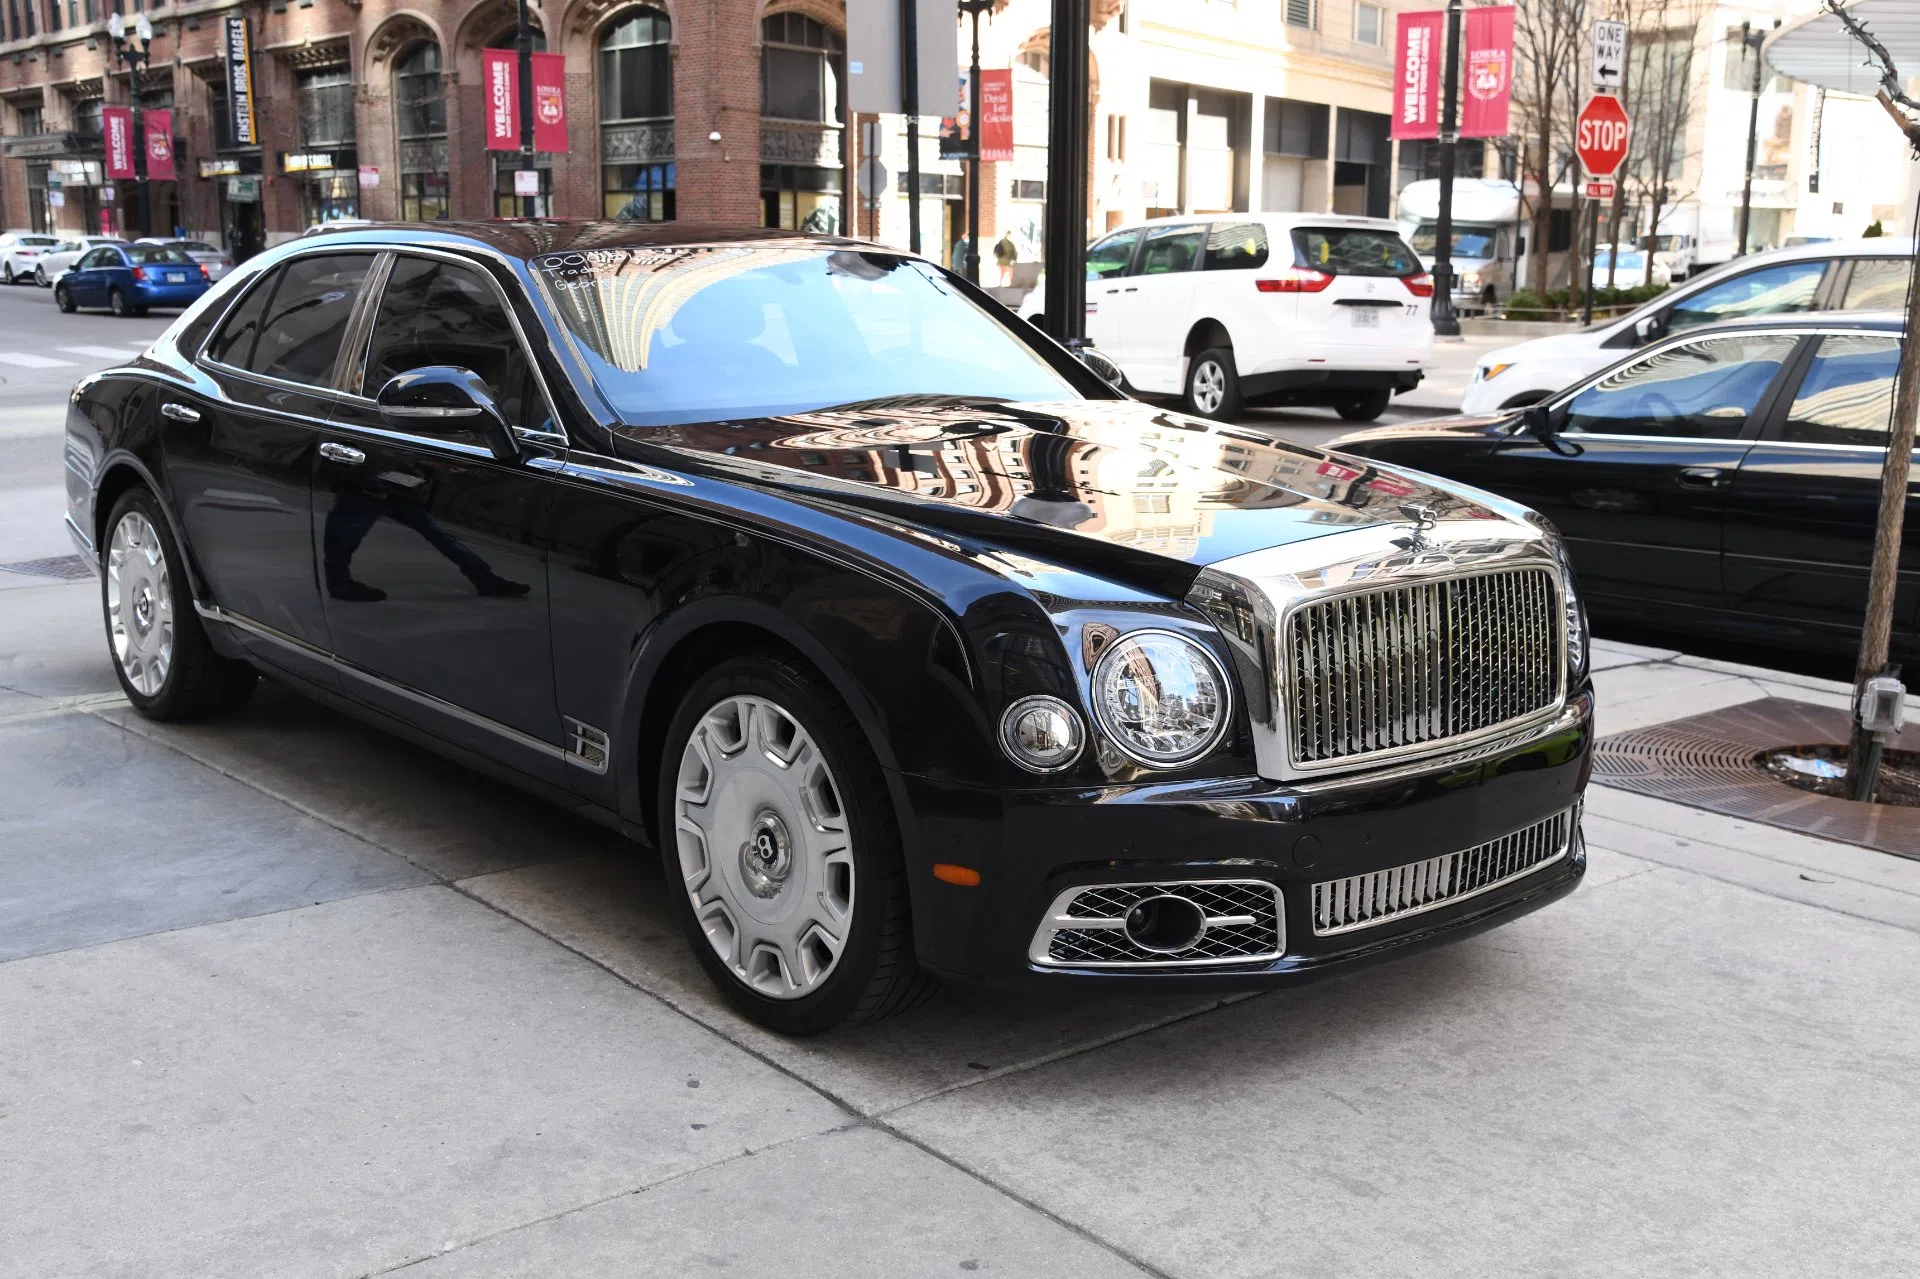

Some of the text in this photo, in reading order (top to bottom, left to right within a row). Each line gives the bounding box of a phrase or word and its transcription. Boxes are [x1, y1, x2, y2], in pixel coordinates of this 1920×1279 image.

[230, 19, 246, 61] BAGELS
[1597, 43, 1621, 61] WAY
[1598, 26, 1622, 43] ONE
[1403, 26, 1422, 124] WELCOME
[236, 94, 251, 142] EINSTEIN
[491, 61, 506, 138] WELCOME
[109, 116, 123, 170] WELCOME
[1579, 118, 1627, 152] STOP
[1588, 185, 1613, 197] ALL WAY
[1406, 304, 1419, 317] 77
